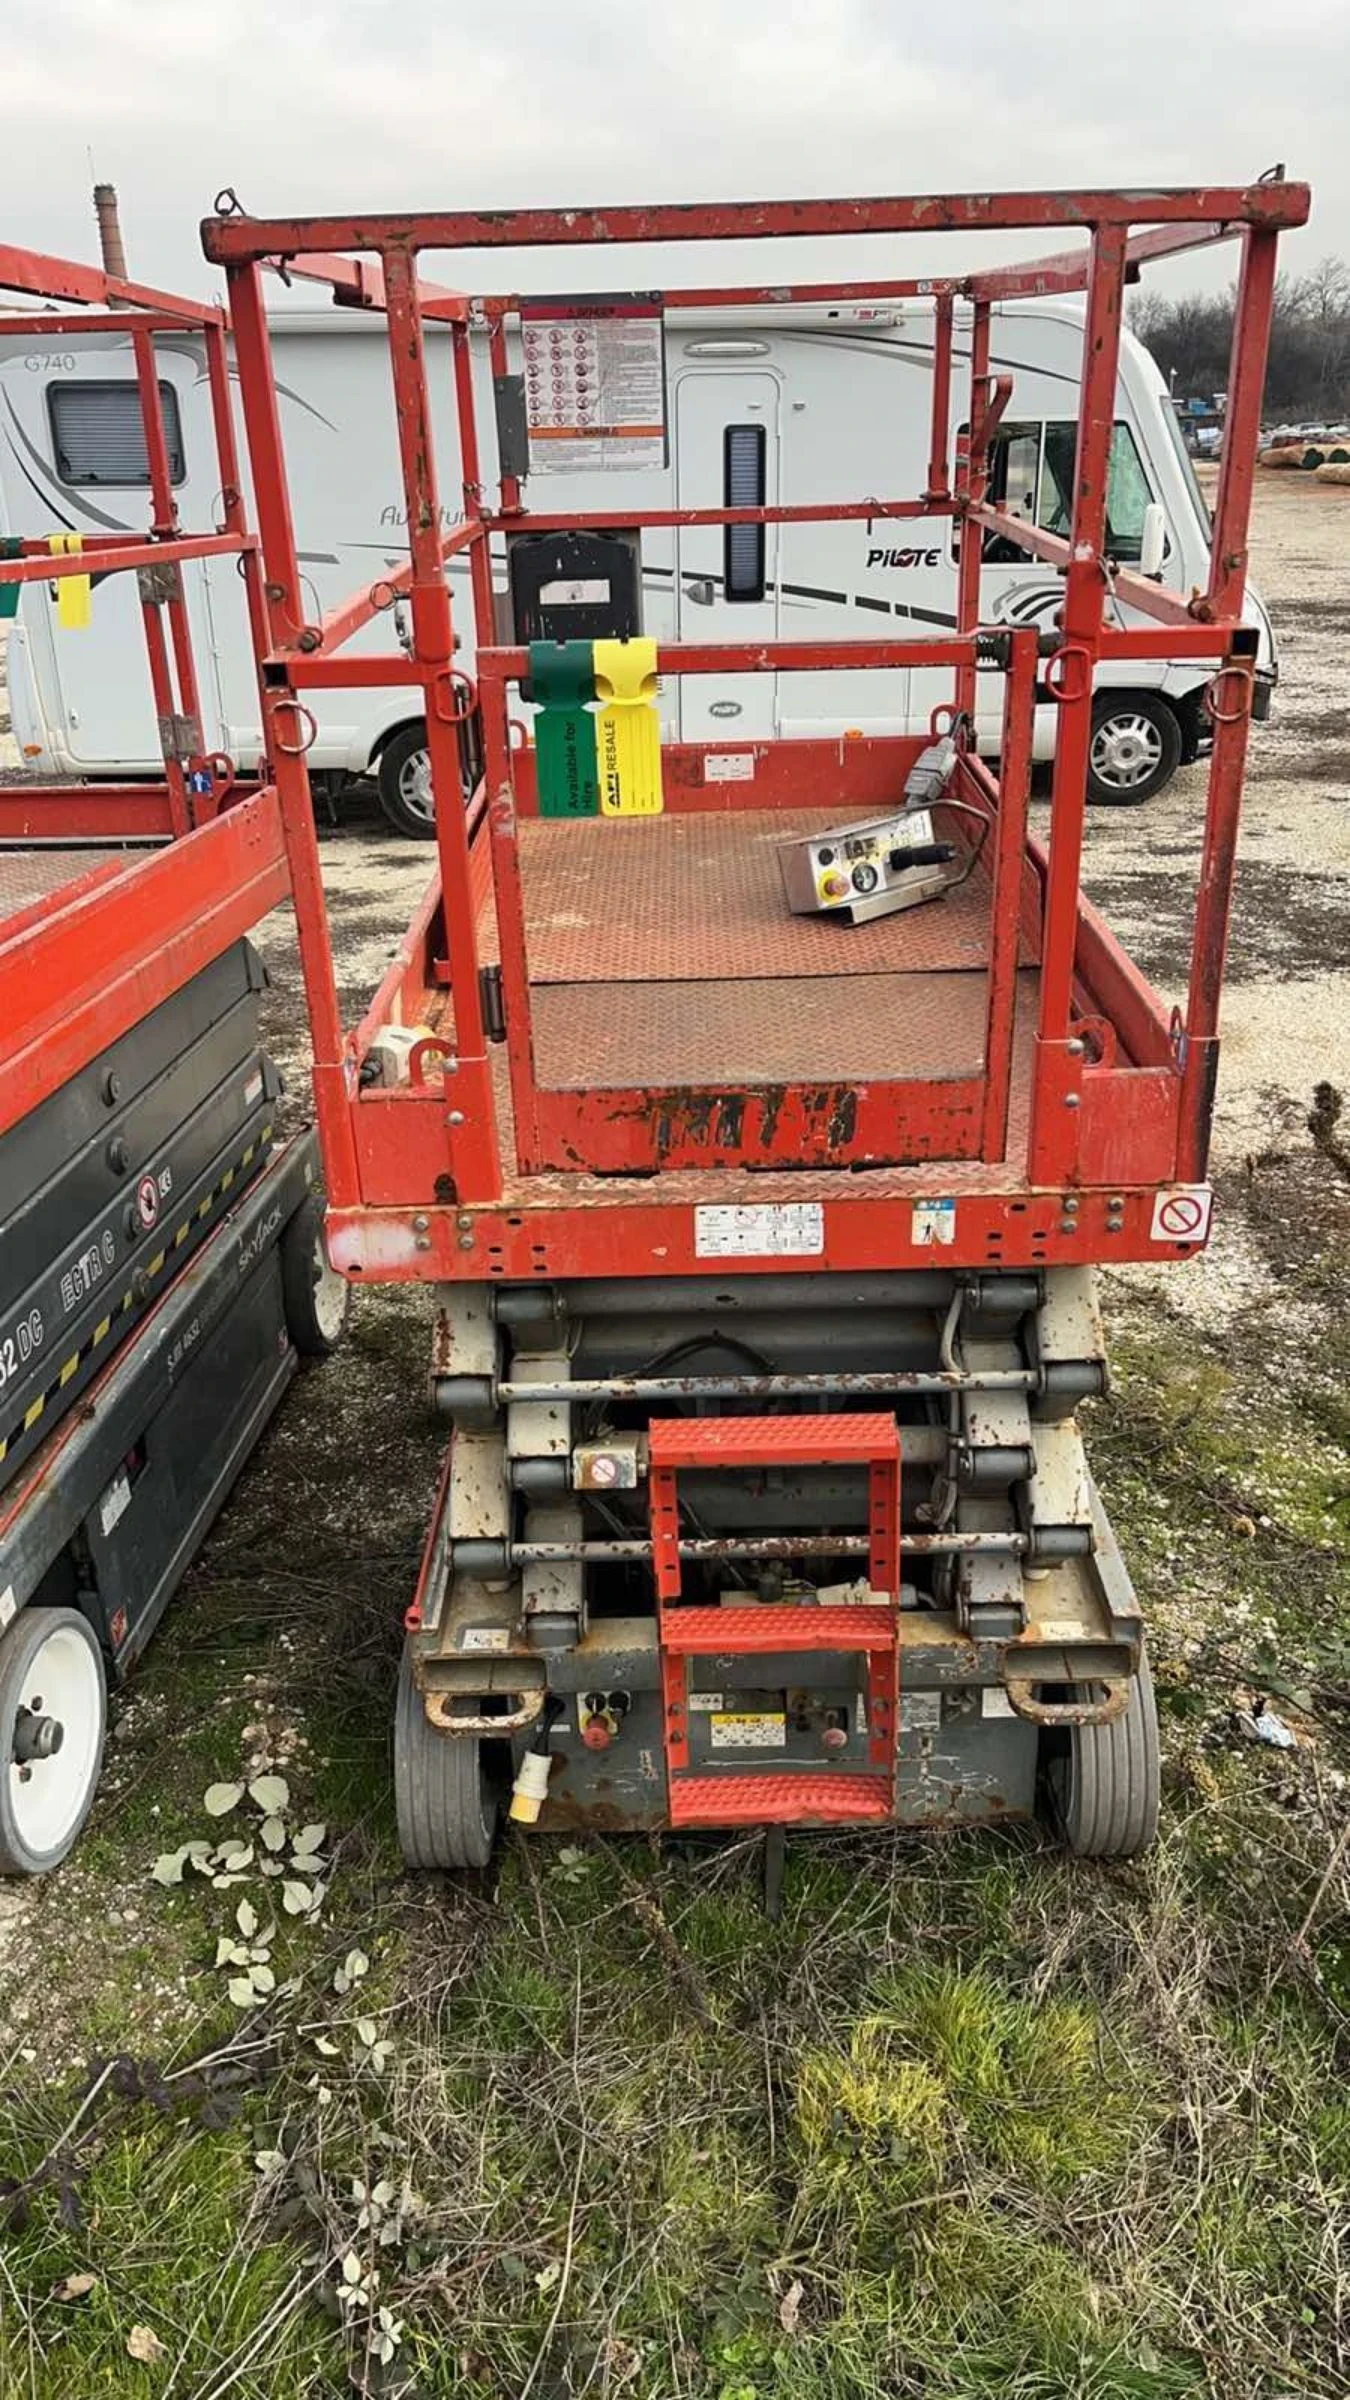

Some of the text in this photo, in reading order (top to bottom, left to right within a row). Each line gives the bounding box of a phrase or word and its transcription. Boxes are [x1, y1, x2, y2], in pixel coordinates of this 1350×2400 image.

[564, 721, 579, 809] Available for
[604, 720, 617, 771] RESALE
[581, 780, 593, 809] Hire
[239, 1204, 283, 1273] SKYJACK
[16, 1308, 43, 1362] DC
